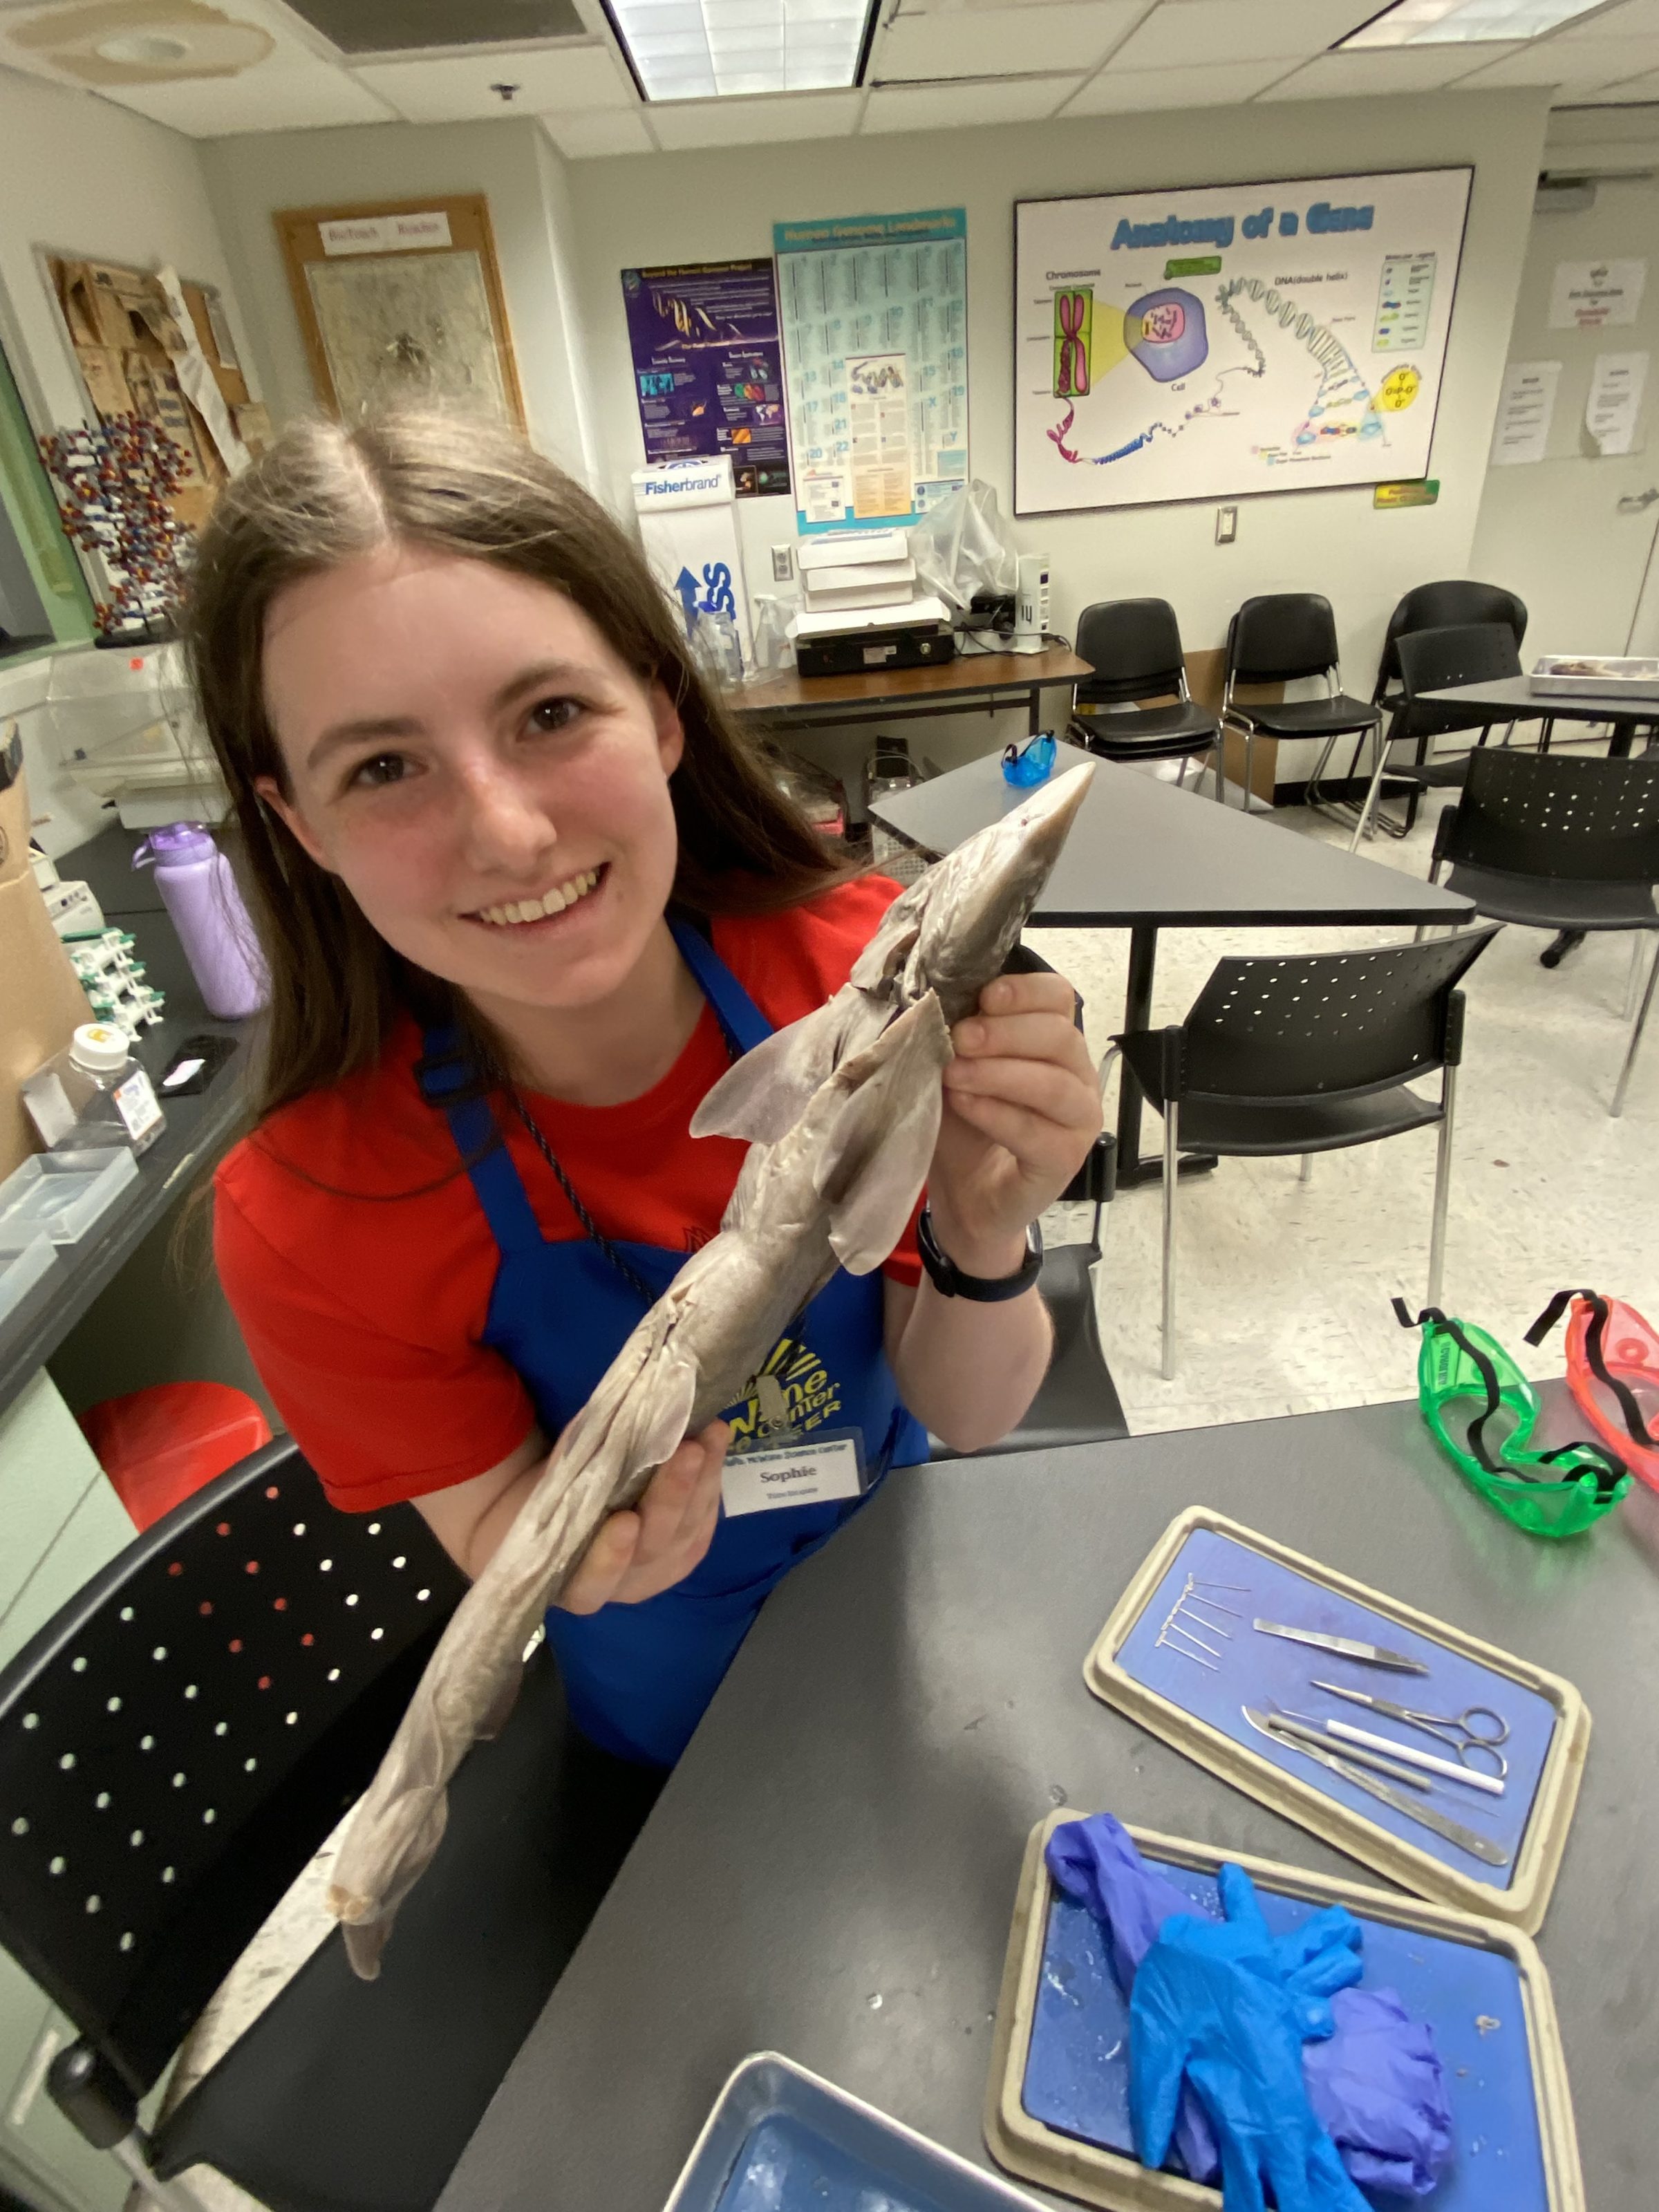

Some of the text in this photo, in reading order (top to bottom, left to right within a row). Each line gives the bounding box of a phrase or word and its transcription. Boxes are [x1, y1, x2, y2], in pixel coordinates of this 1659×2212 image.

[1110, 203, 1375, 250] Anatomy of a Gene
[1046, 269, 1101, 281] Chromosome
[1171, 383, 1185, 393] Cell
[929, 397, 936, 407] X
[834, 418, 847, 429] 21
[950, 431, 957, 442] Y
[836, 441, 849, 452] 22
[809, 447, 823, 459] 20
[645, 476, 719, 496] Fisherbrand
[760, 1465, 818, 1483] Sophie
